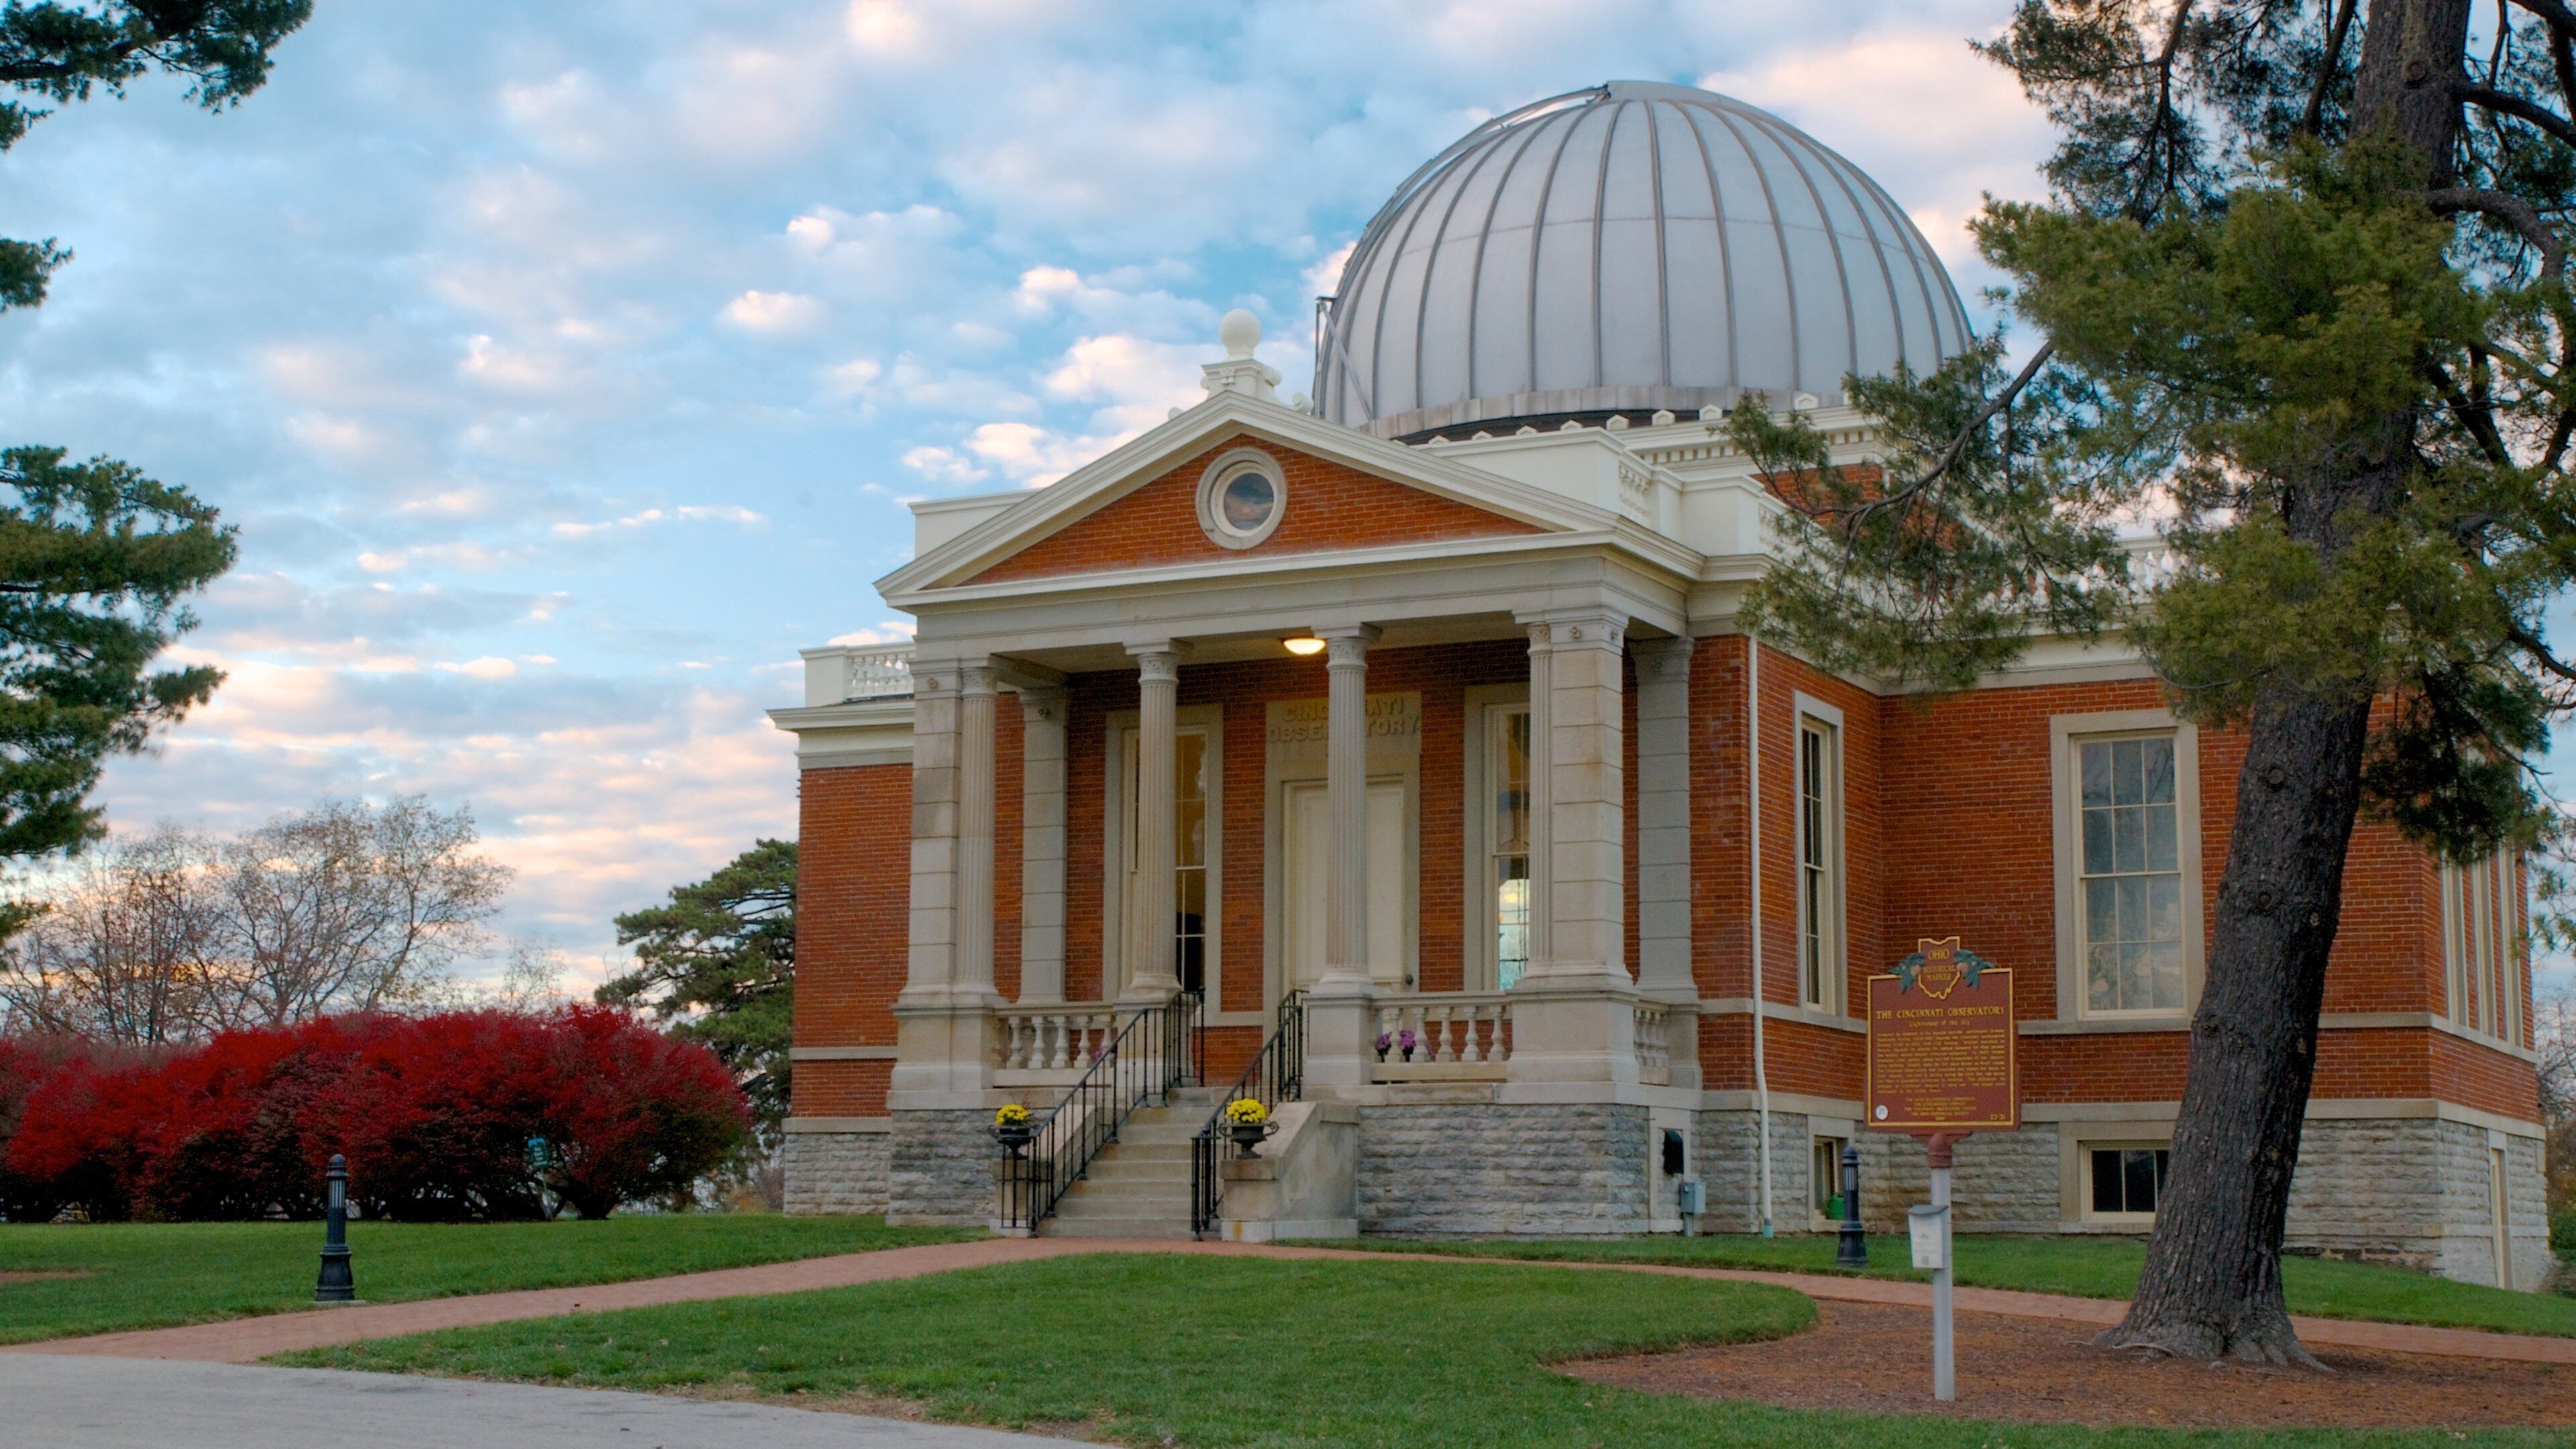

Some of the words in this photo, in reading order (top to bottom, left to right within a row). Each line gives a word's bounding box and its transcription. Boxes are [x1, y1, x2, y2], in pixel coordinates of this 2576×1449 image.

[1927, 948, 1949, 961] OHIO
[1876, 1010, 1892, 1020] THE
[1896, 1008, 1943, 1018] CINCINNATI
[1947, 1006, 2004, 1016] OBSERVATORY
